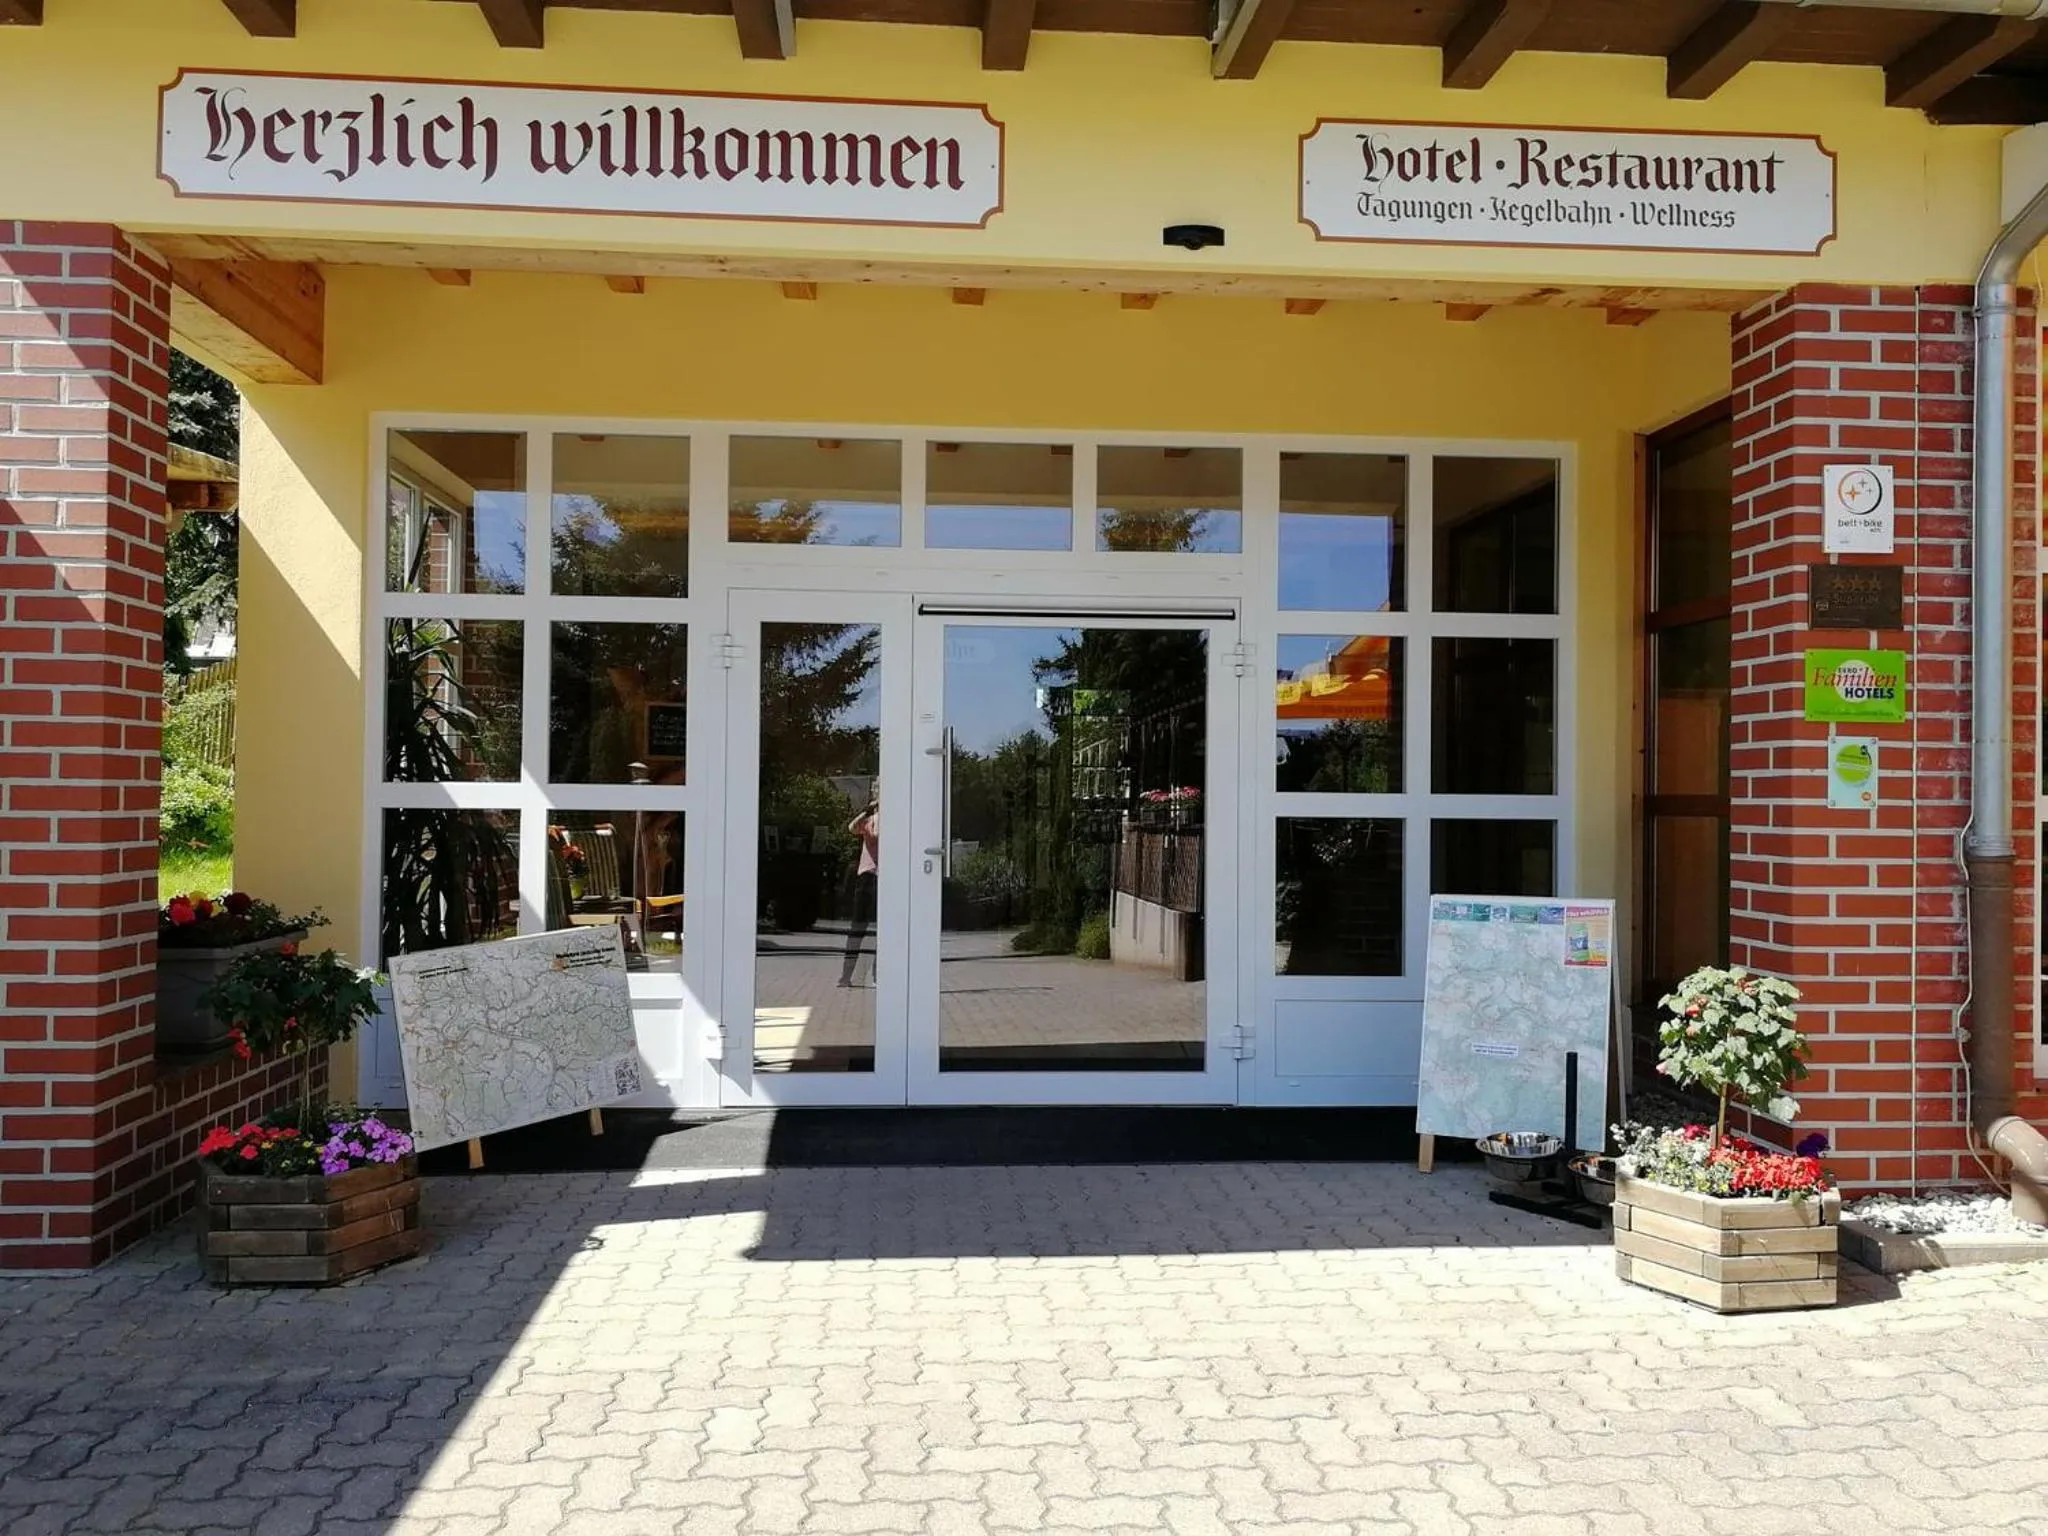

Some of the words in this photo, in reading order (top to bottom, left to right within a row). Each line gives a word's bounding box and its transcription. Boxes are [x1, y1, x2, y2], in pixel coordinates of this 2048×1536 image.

[194, 86, 498, 184] Herzlich
[526, 104, 965, 191] willkommen
[1355, 133, 1483, 194] Hotel
[1507, 137, 1785, 195] Restaurant
[1357, 191, 1473, 225] Tagungen
[1489, 195, 1612, 228] Kegelbahn
[1630, 200, 1735, 229] Wellness
[1812, 667, 1897, 687] Familien
[1844, 687, 1895, 699] HOTELS
